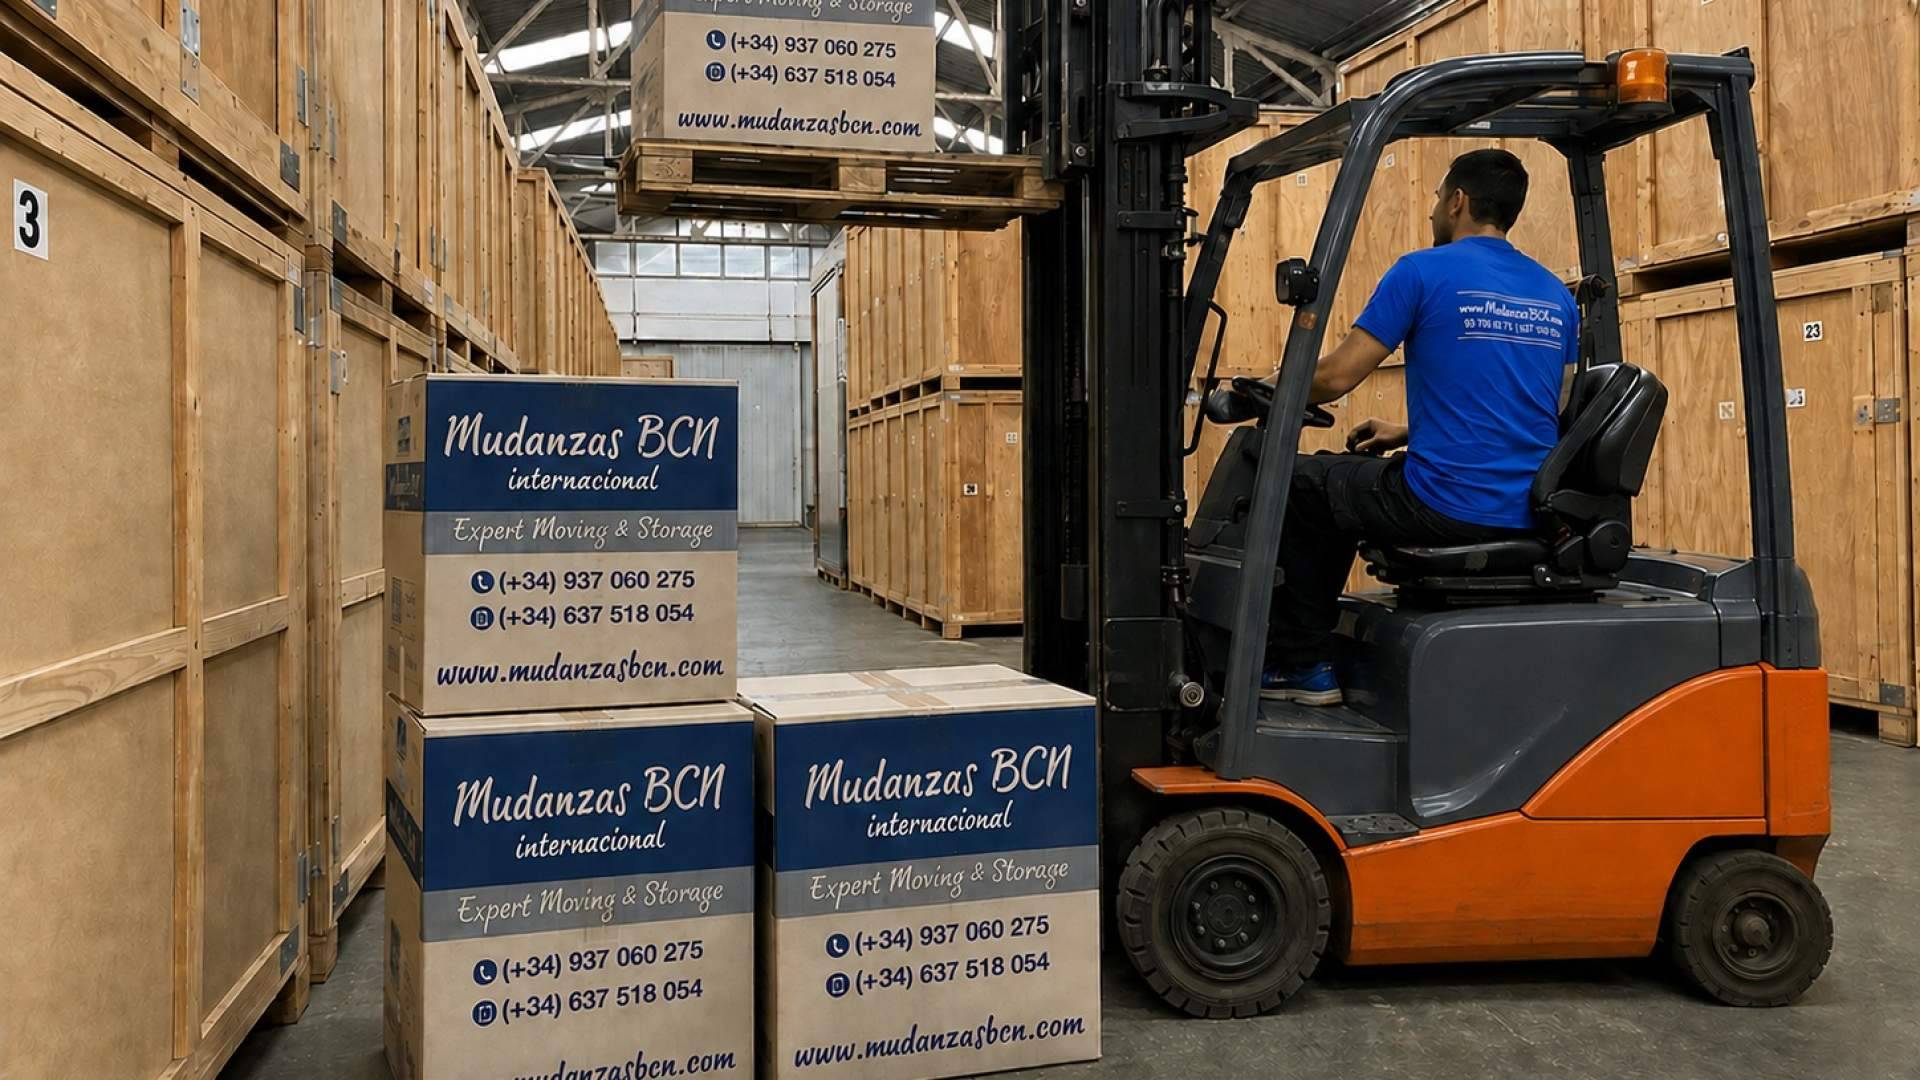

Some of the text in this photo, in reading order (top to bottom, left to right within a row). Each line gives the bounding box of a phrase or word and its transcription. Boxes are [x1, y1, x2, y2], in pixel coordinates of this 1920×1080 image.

[759, 0, 822, 17] oving
[731, 32, 897, 58] (+34) 937 060 275
[731, 63, 897, 88] (+34) 637 518 054
[678, 108, 922, 137] www.mudanzasbcn.com
[19, 190, 40, 248] 3
[1805, 324, 1821, 338] 23
[443, 412, 623, 460] Mudanzas
[637, 414, 720, 460] BCN
[508, 464, 660, 490] internacional
[453, 516, 713, 552] Expert Moving & Storage
[499, 570, 695, 595] (+34) 937 060 275
[499, 604, 694, 630] (+34) 637 518 054
[437, 649, 724, 686] www.mudanzasbcn.com
[453, 774, 631, 827] Mudanzas
[644, 762, 726, 813] BCN
[804, 744, 1072, 809] Mudanzas BCN
[866, 799, 1014, 838] internacional
[516, 820, 666, 859] internacional
[810, 858, 1069, 909] Expert Moving & Storage
[458, 880, 723, 934] Expert Moving & Storage
[855, 915, 1049, 956] (+34) 937 060 275
[502, 940, 703, 984] (+34) 937 060 275
[855, 952, 1050, 996] (+34) 637 518 054
[502, 979, 703, 1024] (+34) 637 518 054
[794, 1014, 1086, 1068] www.mudanzasbcn.com
[513, 1050, 736, 1080] danzasbcn.com
